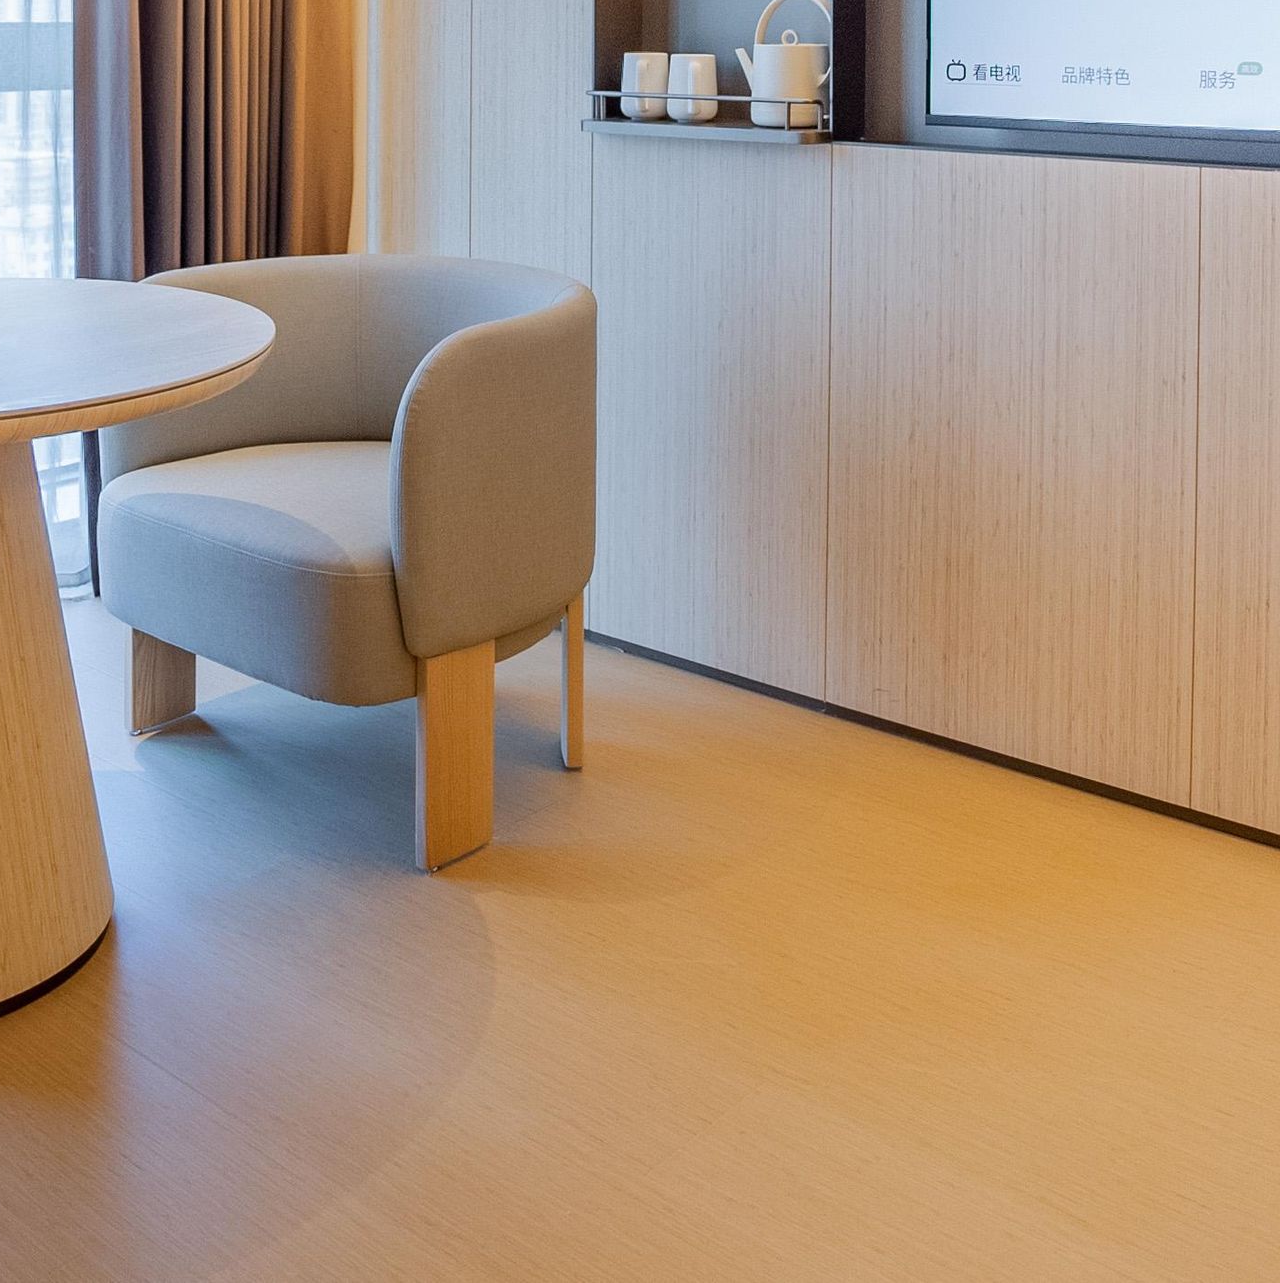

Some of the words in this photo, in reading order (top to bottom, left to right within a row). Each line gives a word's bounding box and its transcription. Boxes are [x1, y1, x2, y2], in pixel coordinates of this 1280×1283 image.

[972, 63, 1021, 82] 看电视
[1061, 66, 1131, 87] 品牌特色
[1199, 69, 1236, 90] 服务
